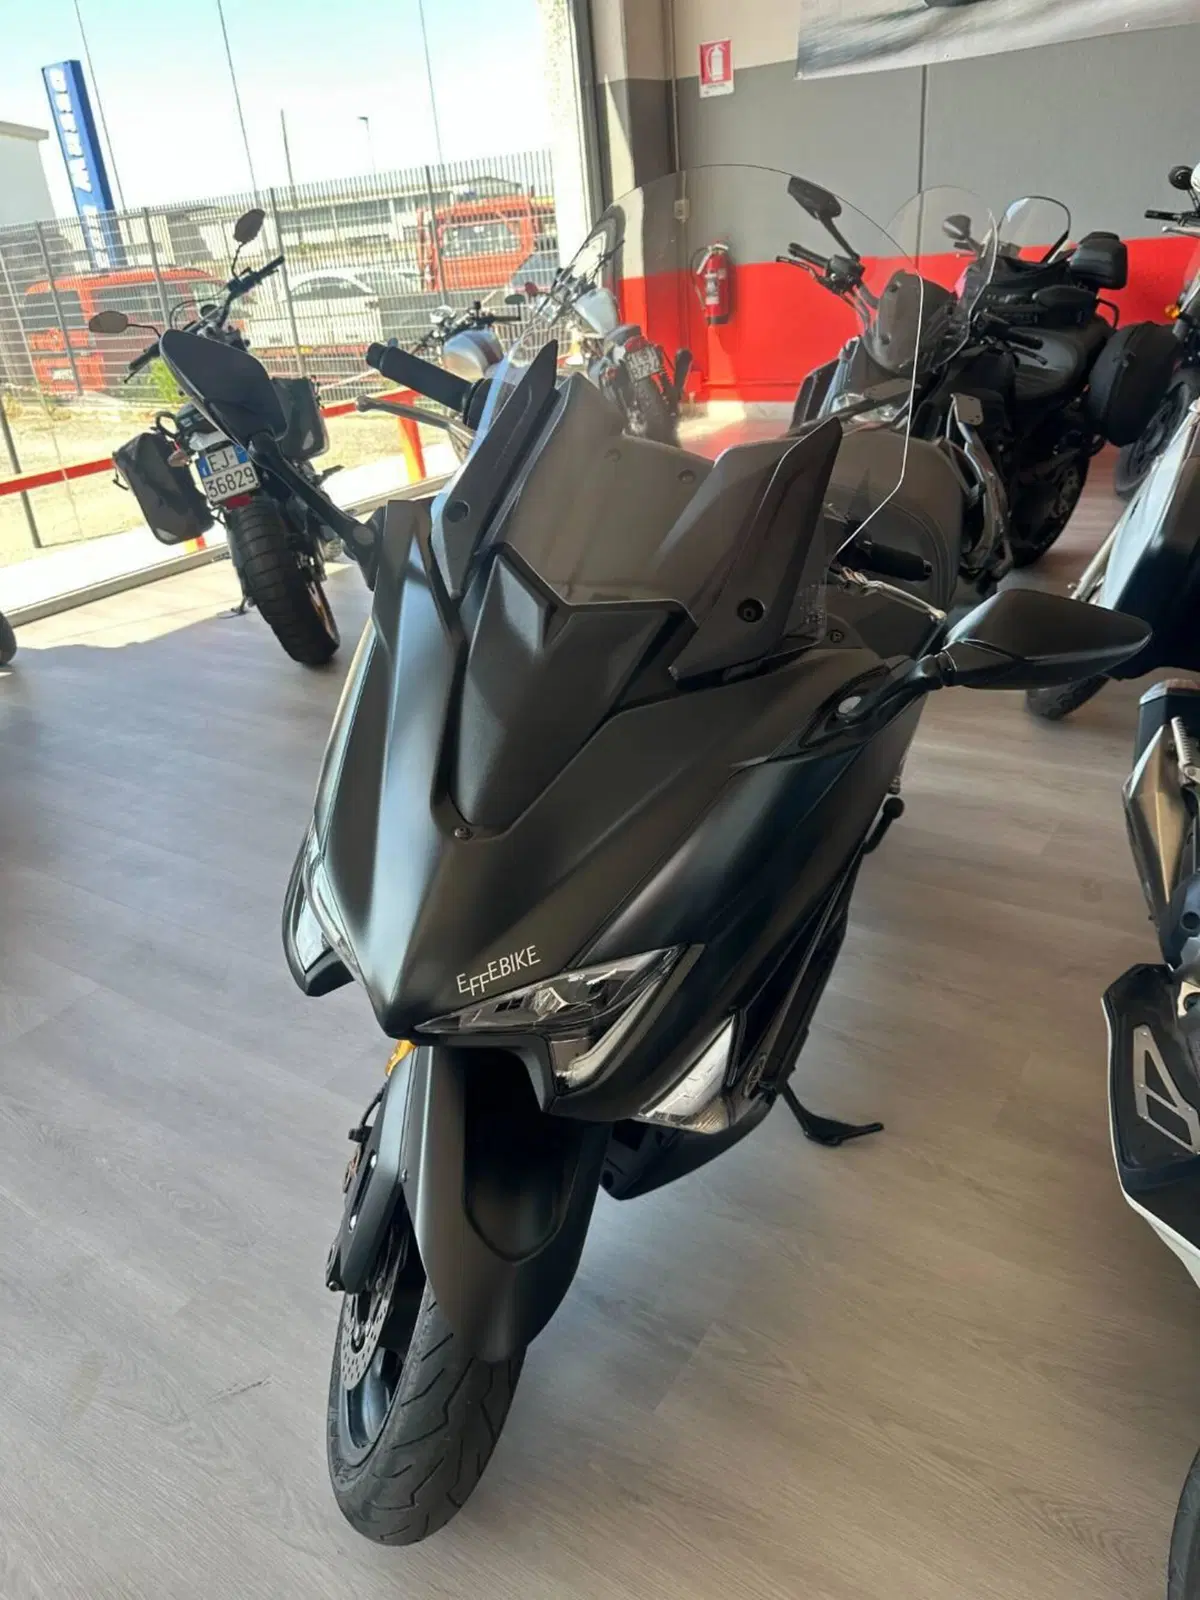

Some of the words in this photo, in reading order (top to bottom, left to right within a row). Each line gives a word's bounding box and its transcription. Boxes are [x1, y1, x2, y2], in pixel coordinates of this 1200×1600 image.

[207, 450, 230, 472] EJ
[205, 466, 256, 497] 36829
[456, 944, 541, 996] EFFEBIKE
